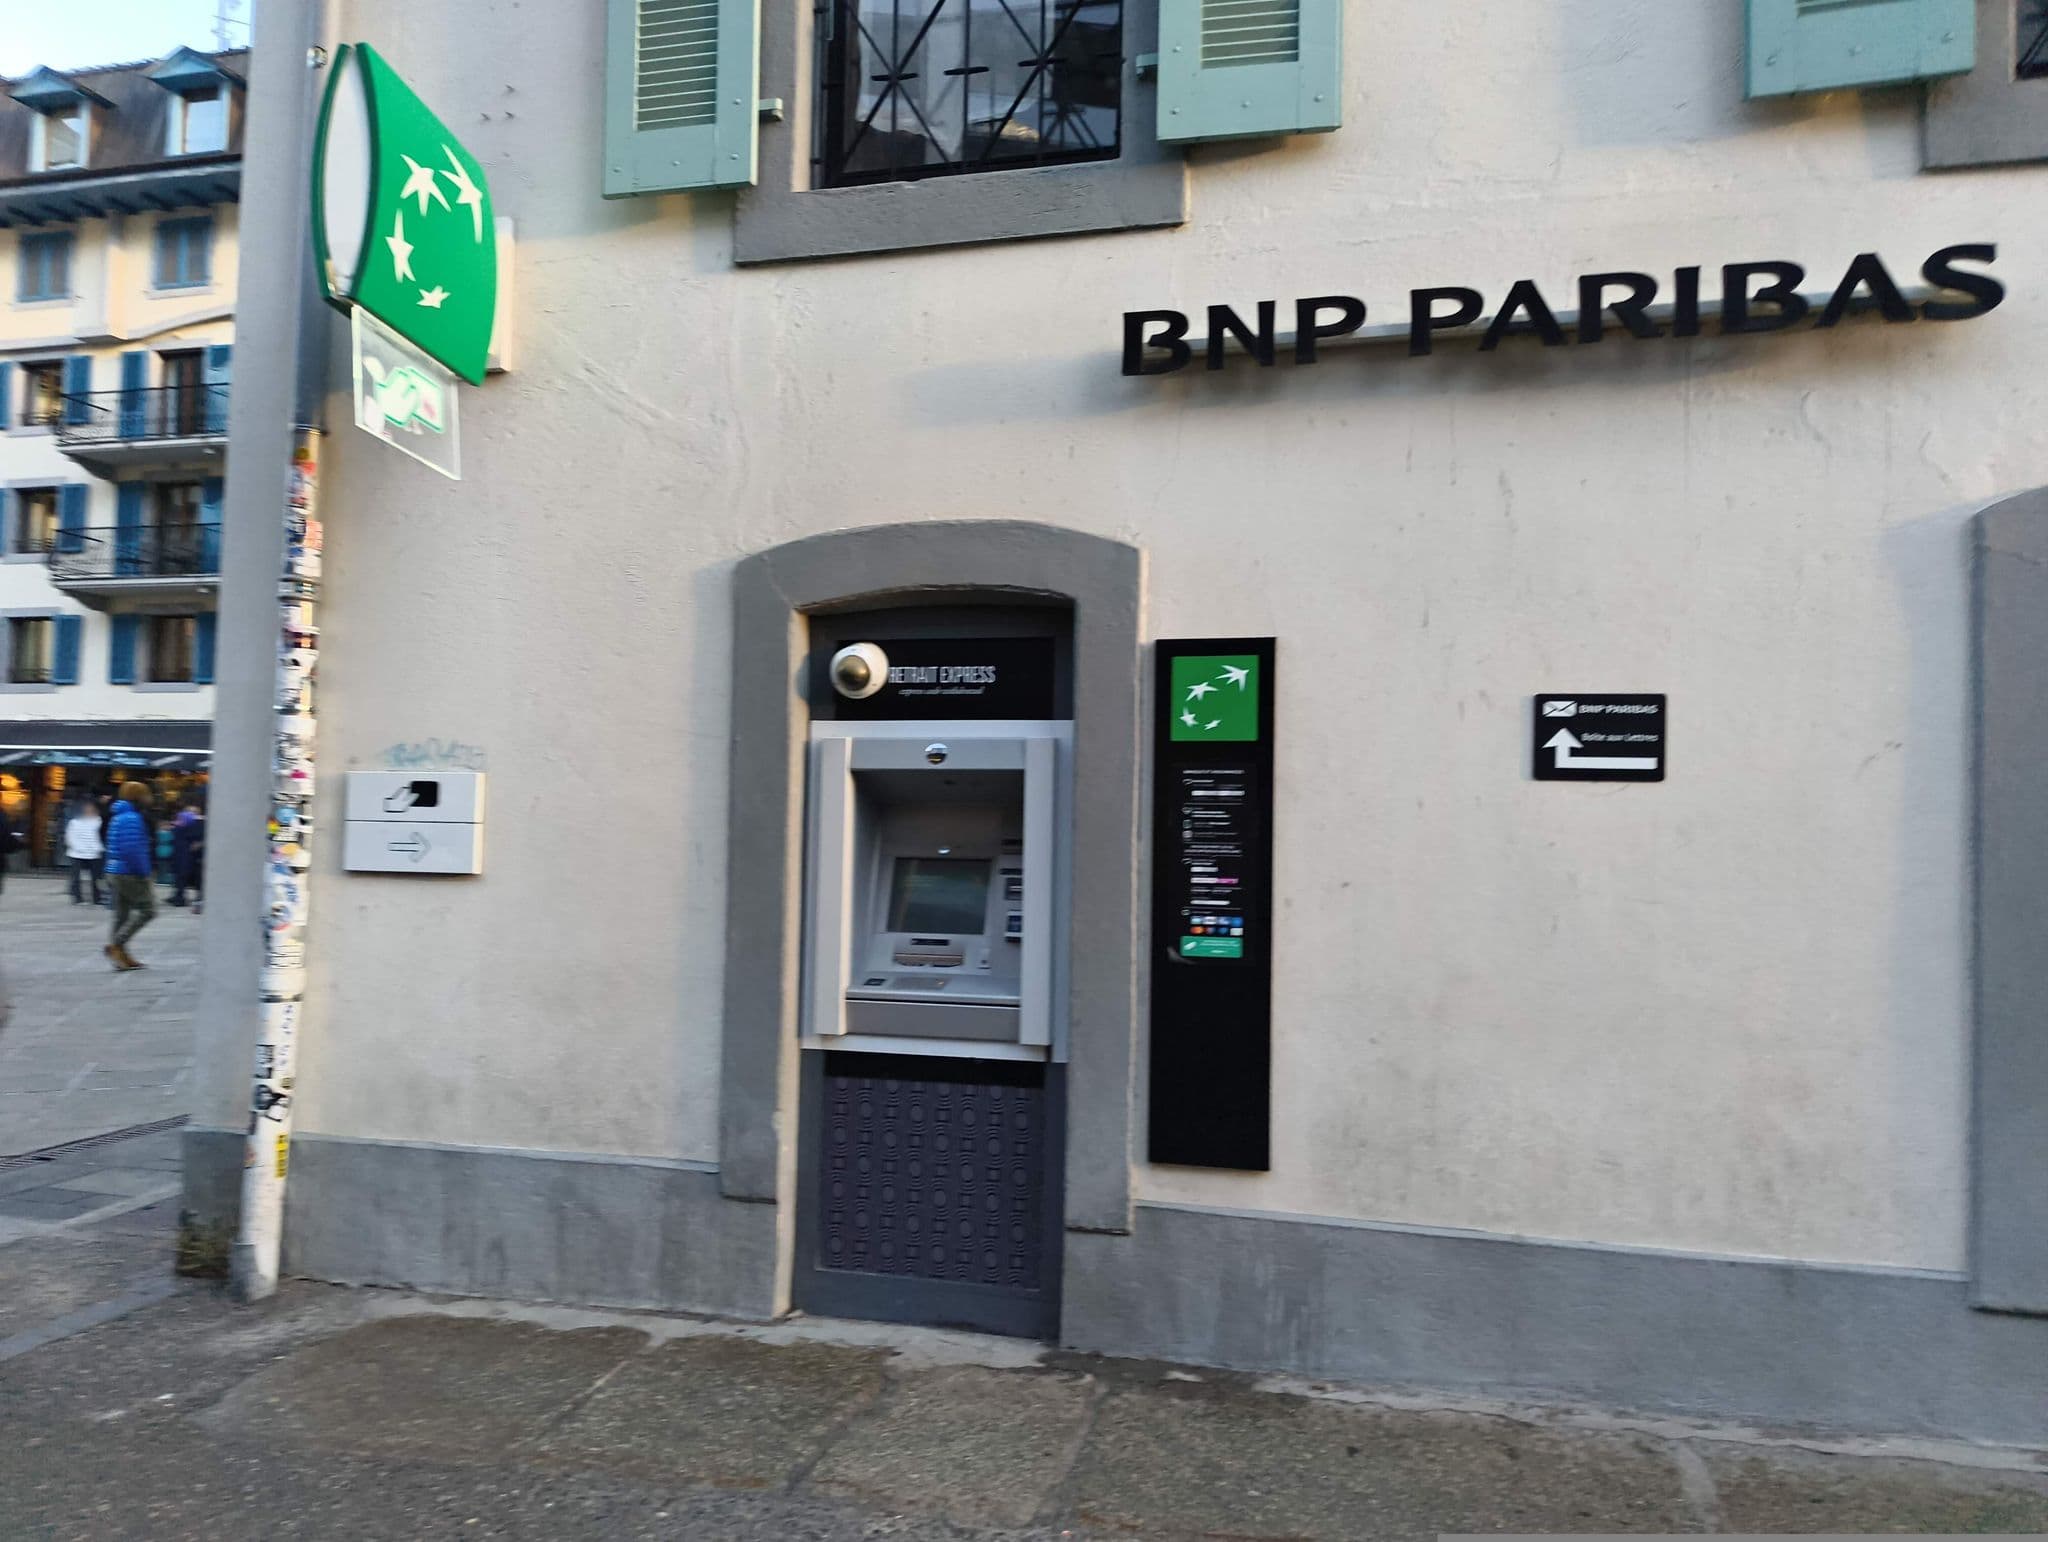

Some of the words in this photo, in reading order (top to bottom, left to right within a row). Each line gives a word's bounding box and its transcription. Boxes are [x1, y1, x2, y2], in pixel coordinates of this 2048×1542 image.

[1122, 296, 1367, 377] BNP
[1408, 243, 2005, 357] PARIBAS
[939, 665, 996, 683] EXPRESS
